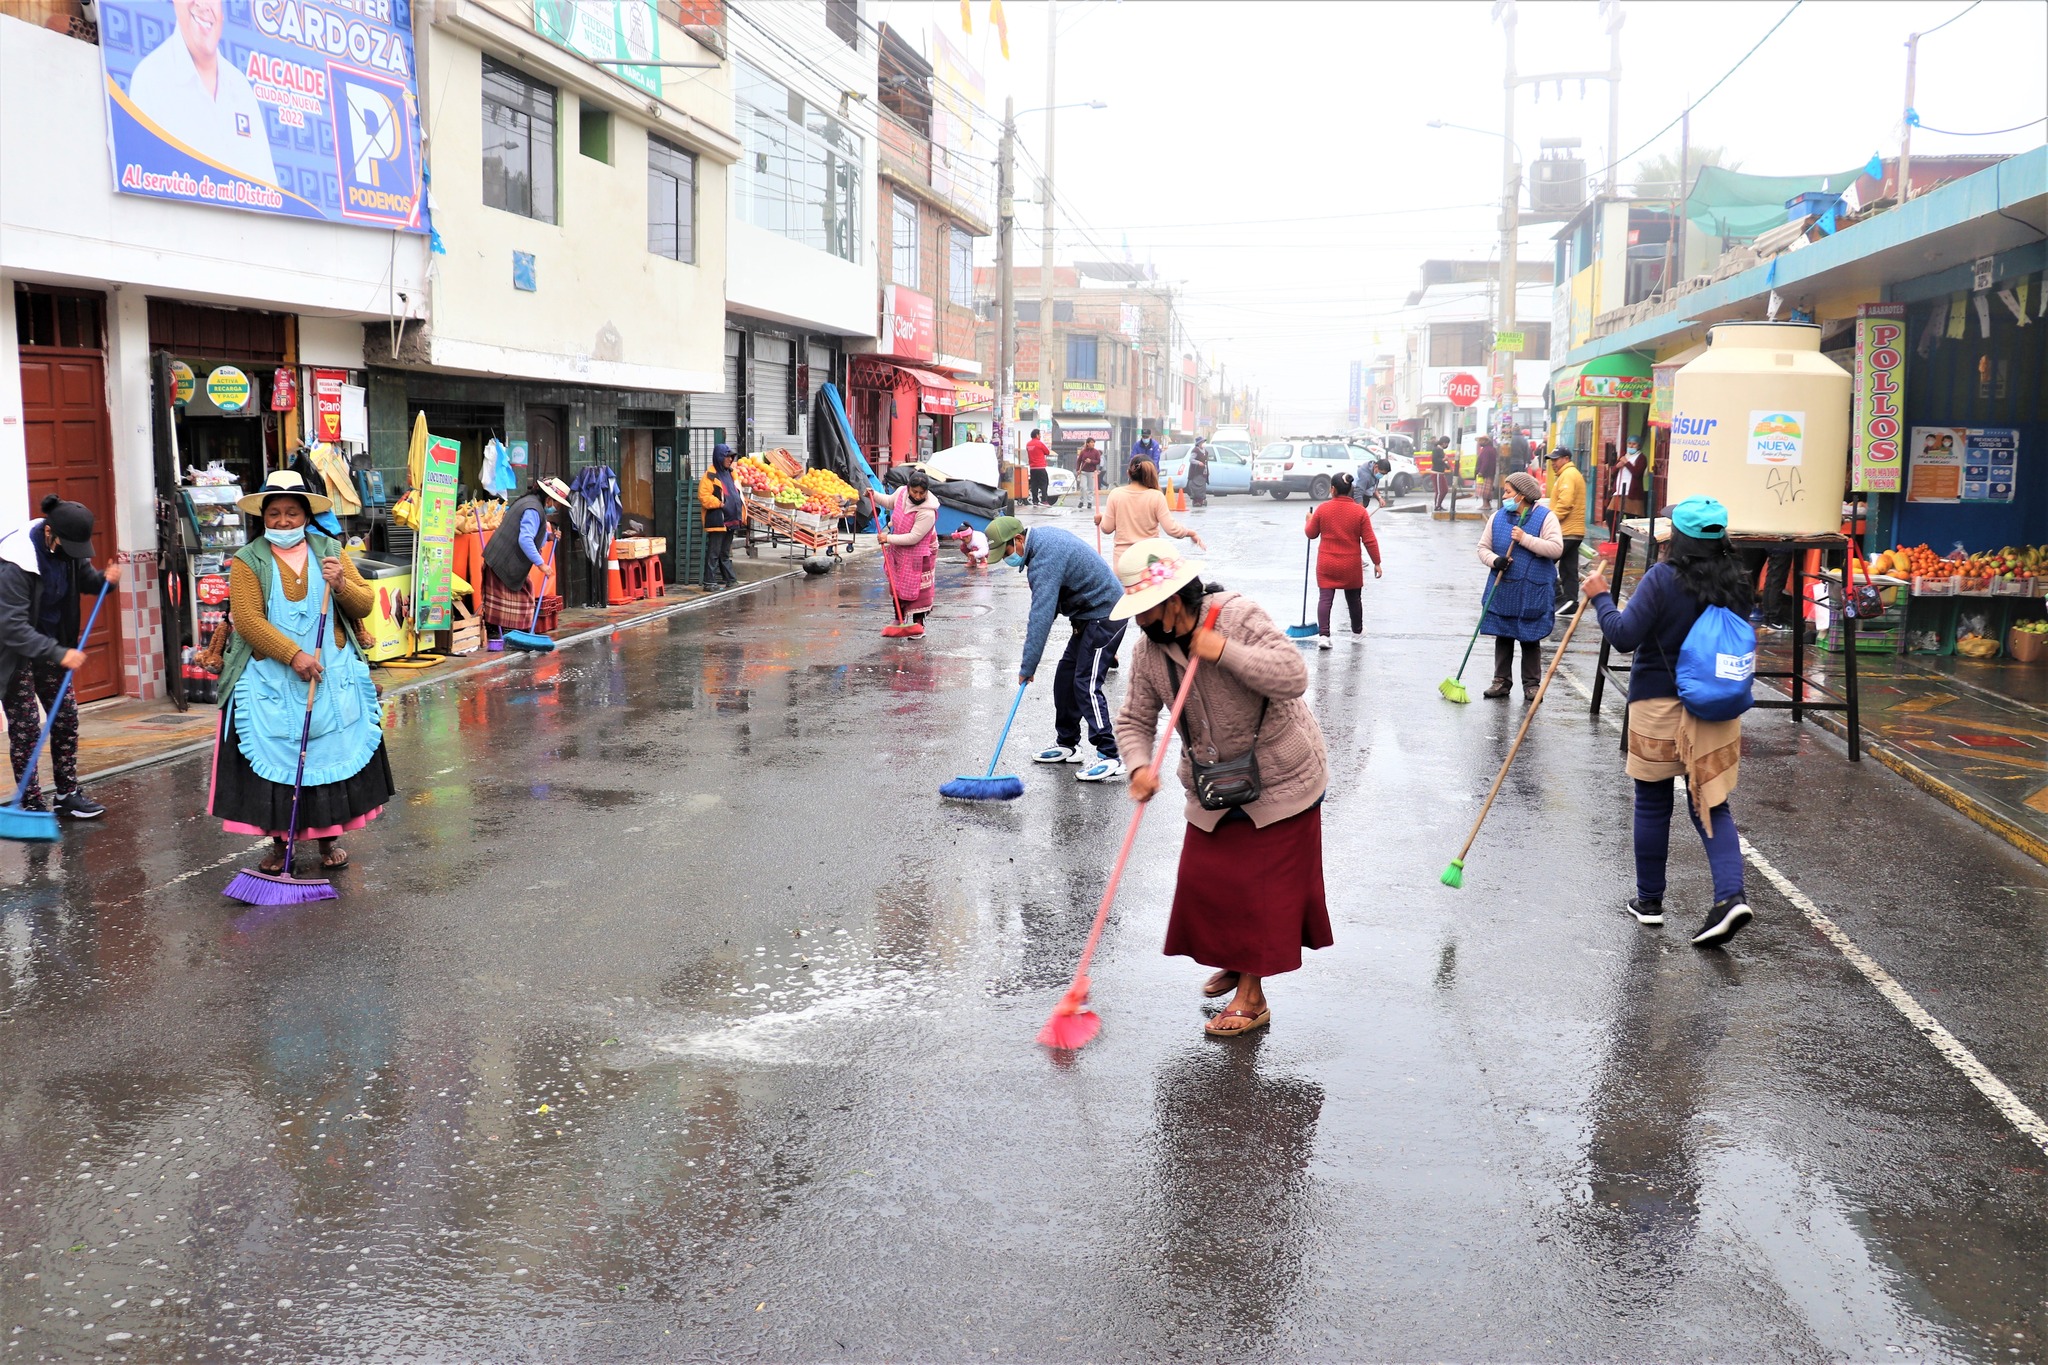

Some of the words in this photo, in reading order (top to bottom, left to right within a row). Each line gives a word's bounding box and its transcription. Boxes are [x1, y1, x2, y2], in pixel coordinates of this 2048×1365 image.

[255, 0, 408, 76] CARDOZA
[581, 13, 613, 40] CIUDAD
[585, 28, 612, 55] NUEVA
[248, 54, 324, 97] ALCALDE
[255, 85, 290, 105] CIUDAD
[291, 95, 321, 113] NUEVA
[279, 108, 304, 126] 2022
[123, 165, 141, 187] Al
[143, 171, 197, 196] servicio
[200, 176, 215, 198] de
[218, 180, 235, 200] mi
[236, 180, 283, 208] Distrito
[348, 186, 411, 214] PODEMOS
[1868, 305, 1905, 315] ABARROTES
[895, 314, 914, 341] Claro
[1449, 383, 1479, 398] PARE
[1853, 321, 1864, 487] EMBUTIDOS
[1868, 325, 1902, 462] POLLOS
[319, 398, 341, 412] Claro
[658, 448, 669, 462] S
[1683, 449, 1700, 463] 600
[1702, 451, 1709, 463] L
[1757, 441, 1796, 452] NUEVA
[1864, 468, 1877, 477] POR
[1878, 468, 1900, 477] MAYOR
[1873, 479, 1896, 488] MENOR
